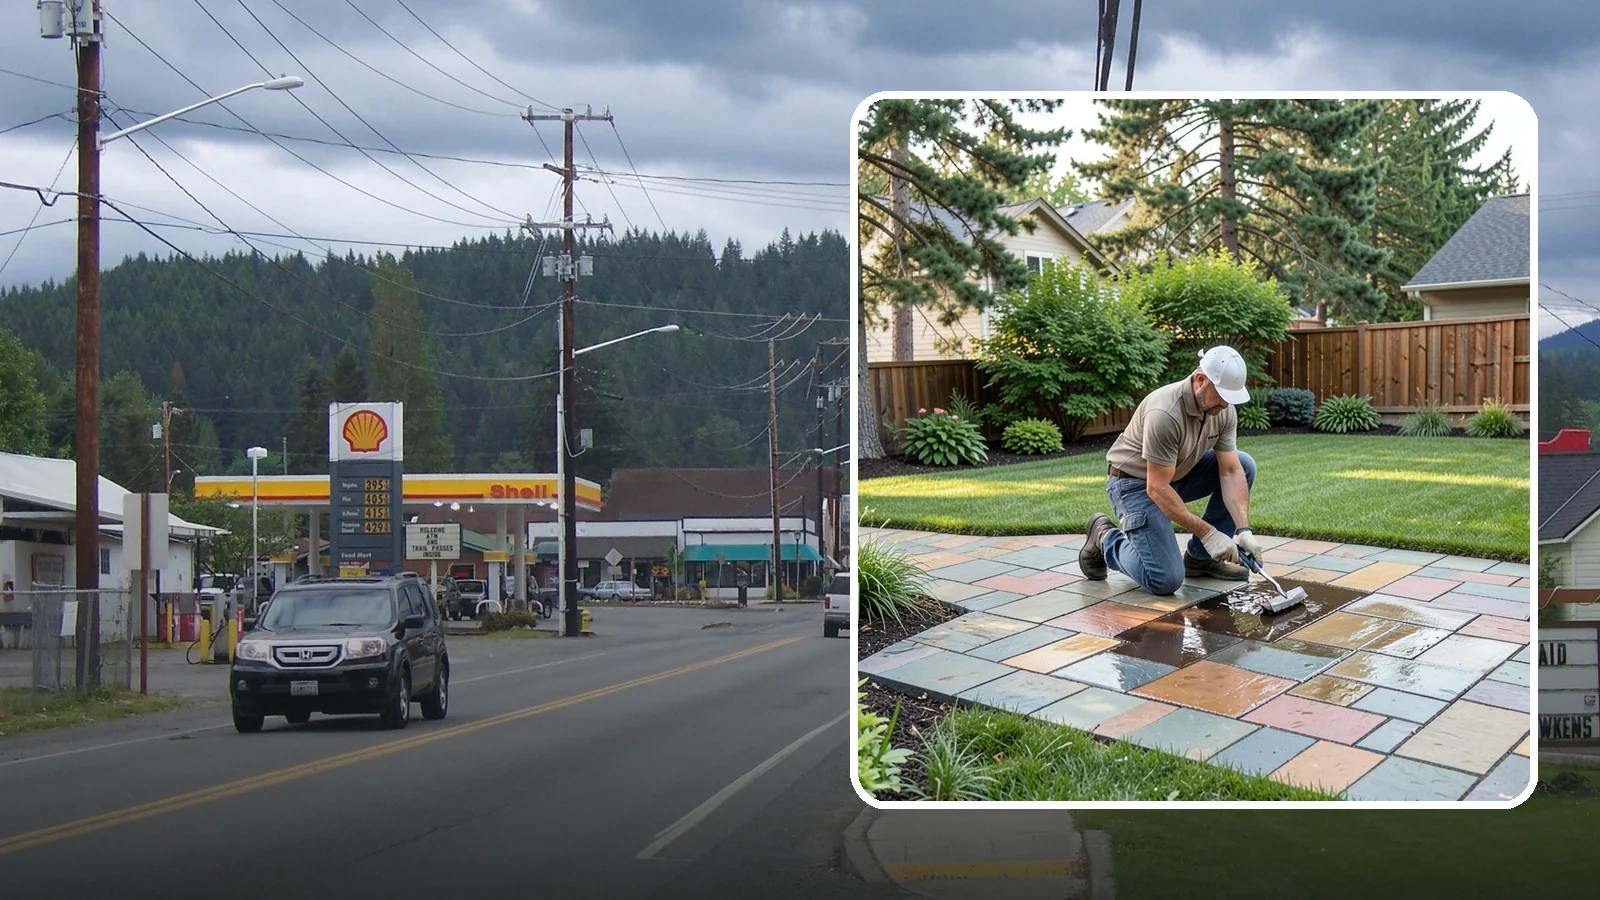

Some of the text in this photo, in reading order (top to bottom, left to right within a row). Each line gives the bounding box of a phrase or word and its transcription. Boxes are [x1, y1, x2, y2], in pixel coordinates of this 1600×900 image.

[366, 480, 383, 490] 395
[490, 484, 547, 498] Shell
[366, 494, 383, 504] 405
[366, 508, 383, 518] 415
[366, 522, 383, 532] 429
[1539, 643, 1566, 666] AID
[1538, 716, 1592, 739] WKENS
